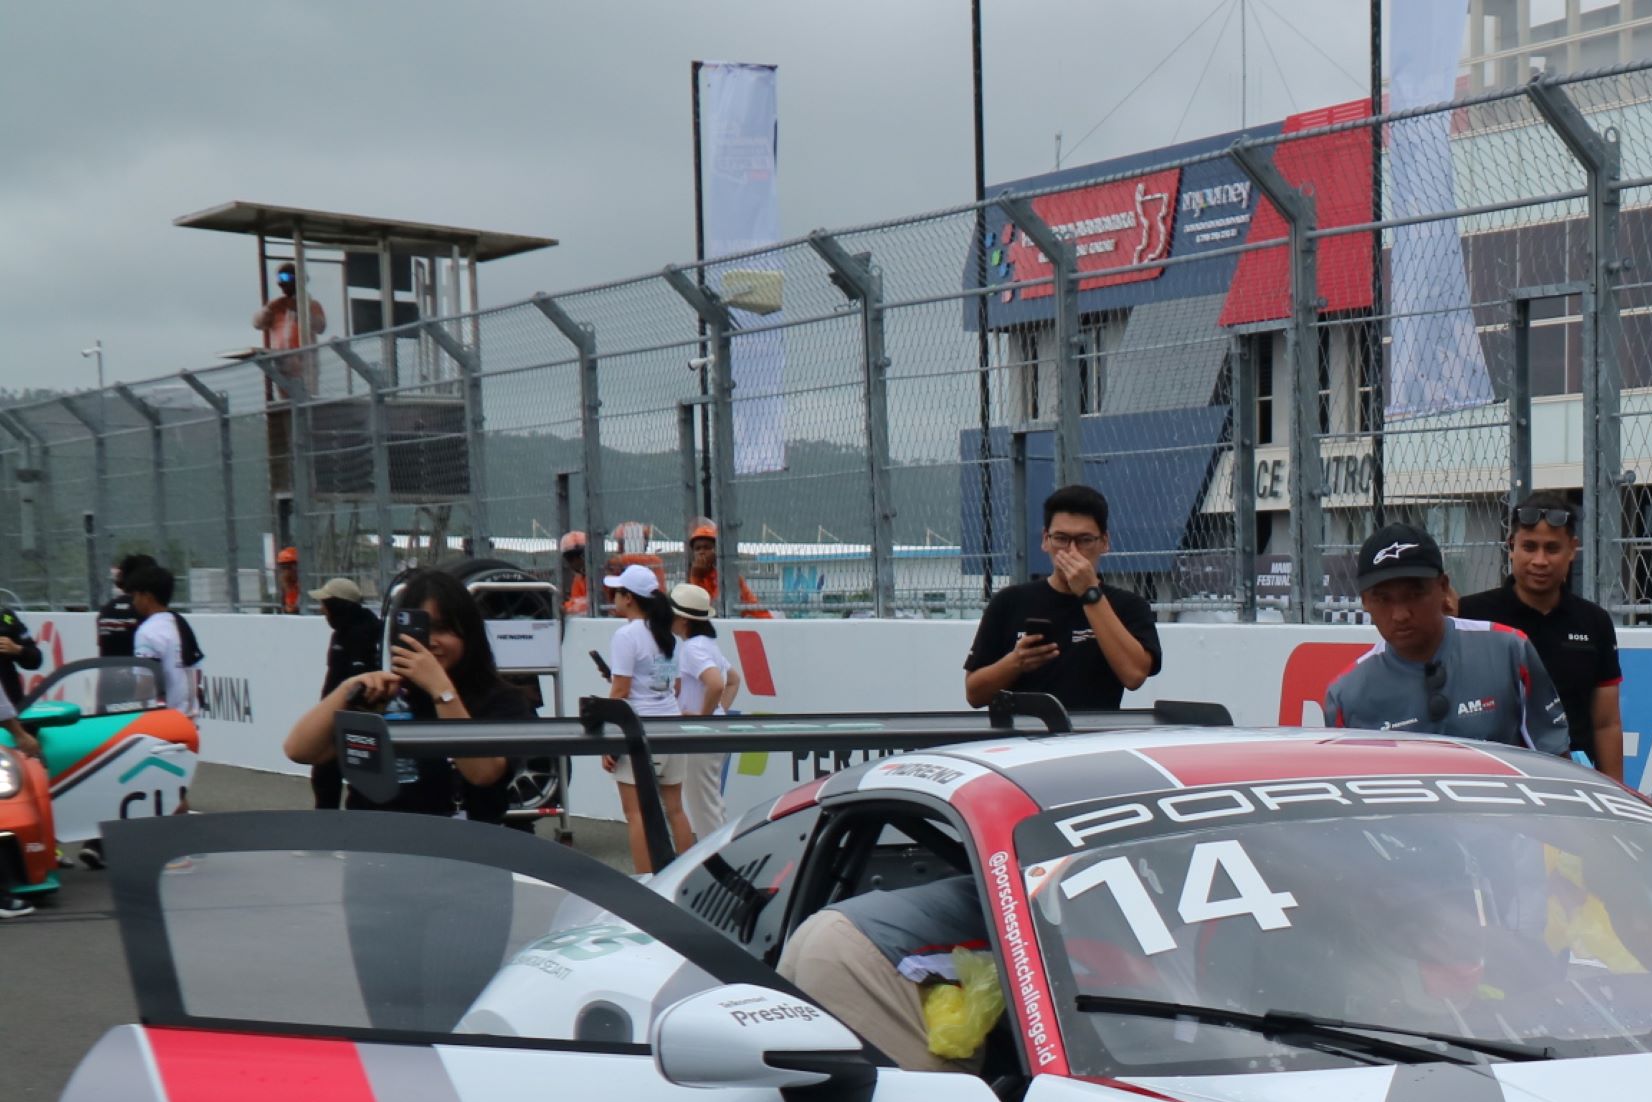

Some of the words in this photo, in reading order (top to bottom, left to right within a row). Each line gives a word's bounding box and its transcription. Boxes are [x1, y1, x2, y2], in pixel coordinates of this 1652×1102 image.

[1567, 633, 1590, 642] BOSS
[1060, 839, 1300, 957] 14
[988, 850, 1057, 1067] @porschesprintchallenge.id
[730, 1002, 821, 1028] Prestige
